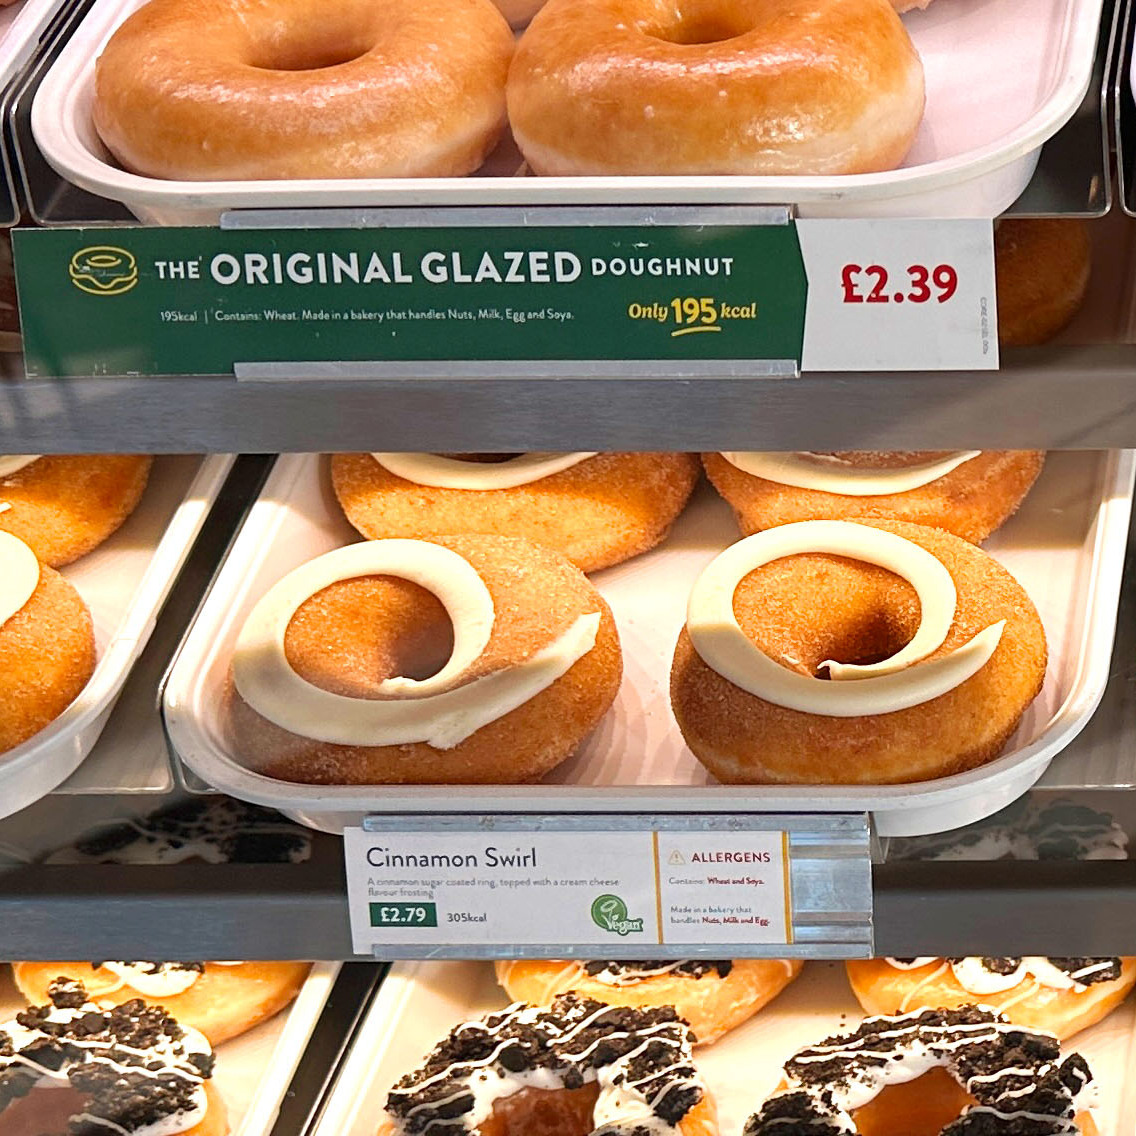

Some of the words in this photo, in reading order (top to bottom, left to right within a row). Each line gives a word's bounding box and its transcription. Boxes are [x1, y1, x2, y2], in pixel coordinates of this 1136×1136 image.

[155, 262, 200, 280] THE
[211, 252, 412, 285] ORIGINAL
[421, 251, 581, 284] GLAZED
[591, 257, 734, 277] DOUGHNUT
[842, 264, 958, 304] £2.39
[160, 311, 198, 321] 195kcal
[302, 310, 330, 320] Made
[331, 310, 340, 320] in
[351, 309, 384, 323] bakery
[386, 309, 407, 320] that
[408, 309, 446, 320] handles
[448, 309, 477, 321] Nuts,
[478, 309, 503, 321] Milk,
[505, 308, 526, 323] Egg
[527, 309, 545, 319] and
[547, 308, 575, 322] Soya.
[629, 302, 668, 323] Only
[671, 297, 717, 323] 195
[720, 302, 756, 320] kcal
[366, 847, 478, 867] Cinnamon
[485, 847, 536, 867] Swirl
[691, 852, 771, 863] ALLERGENS
[380, 907, 426, 922] £2.79
[447, 913, 487, 923] 305kcal
[604, 911, 642, 935] Vegan
